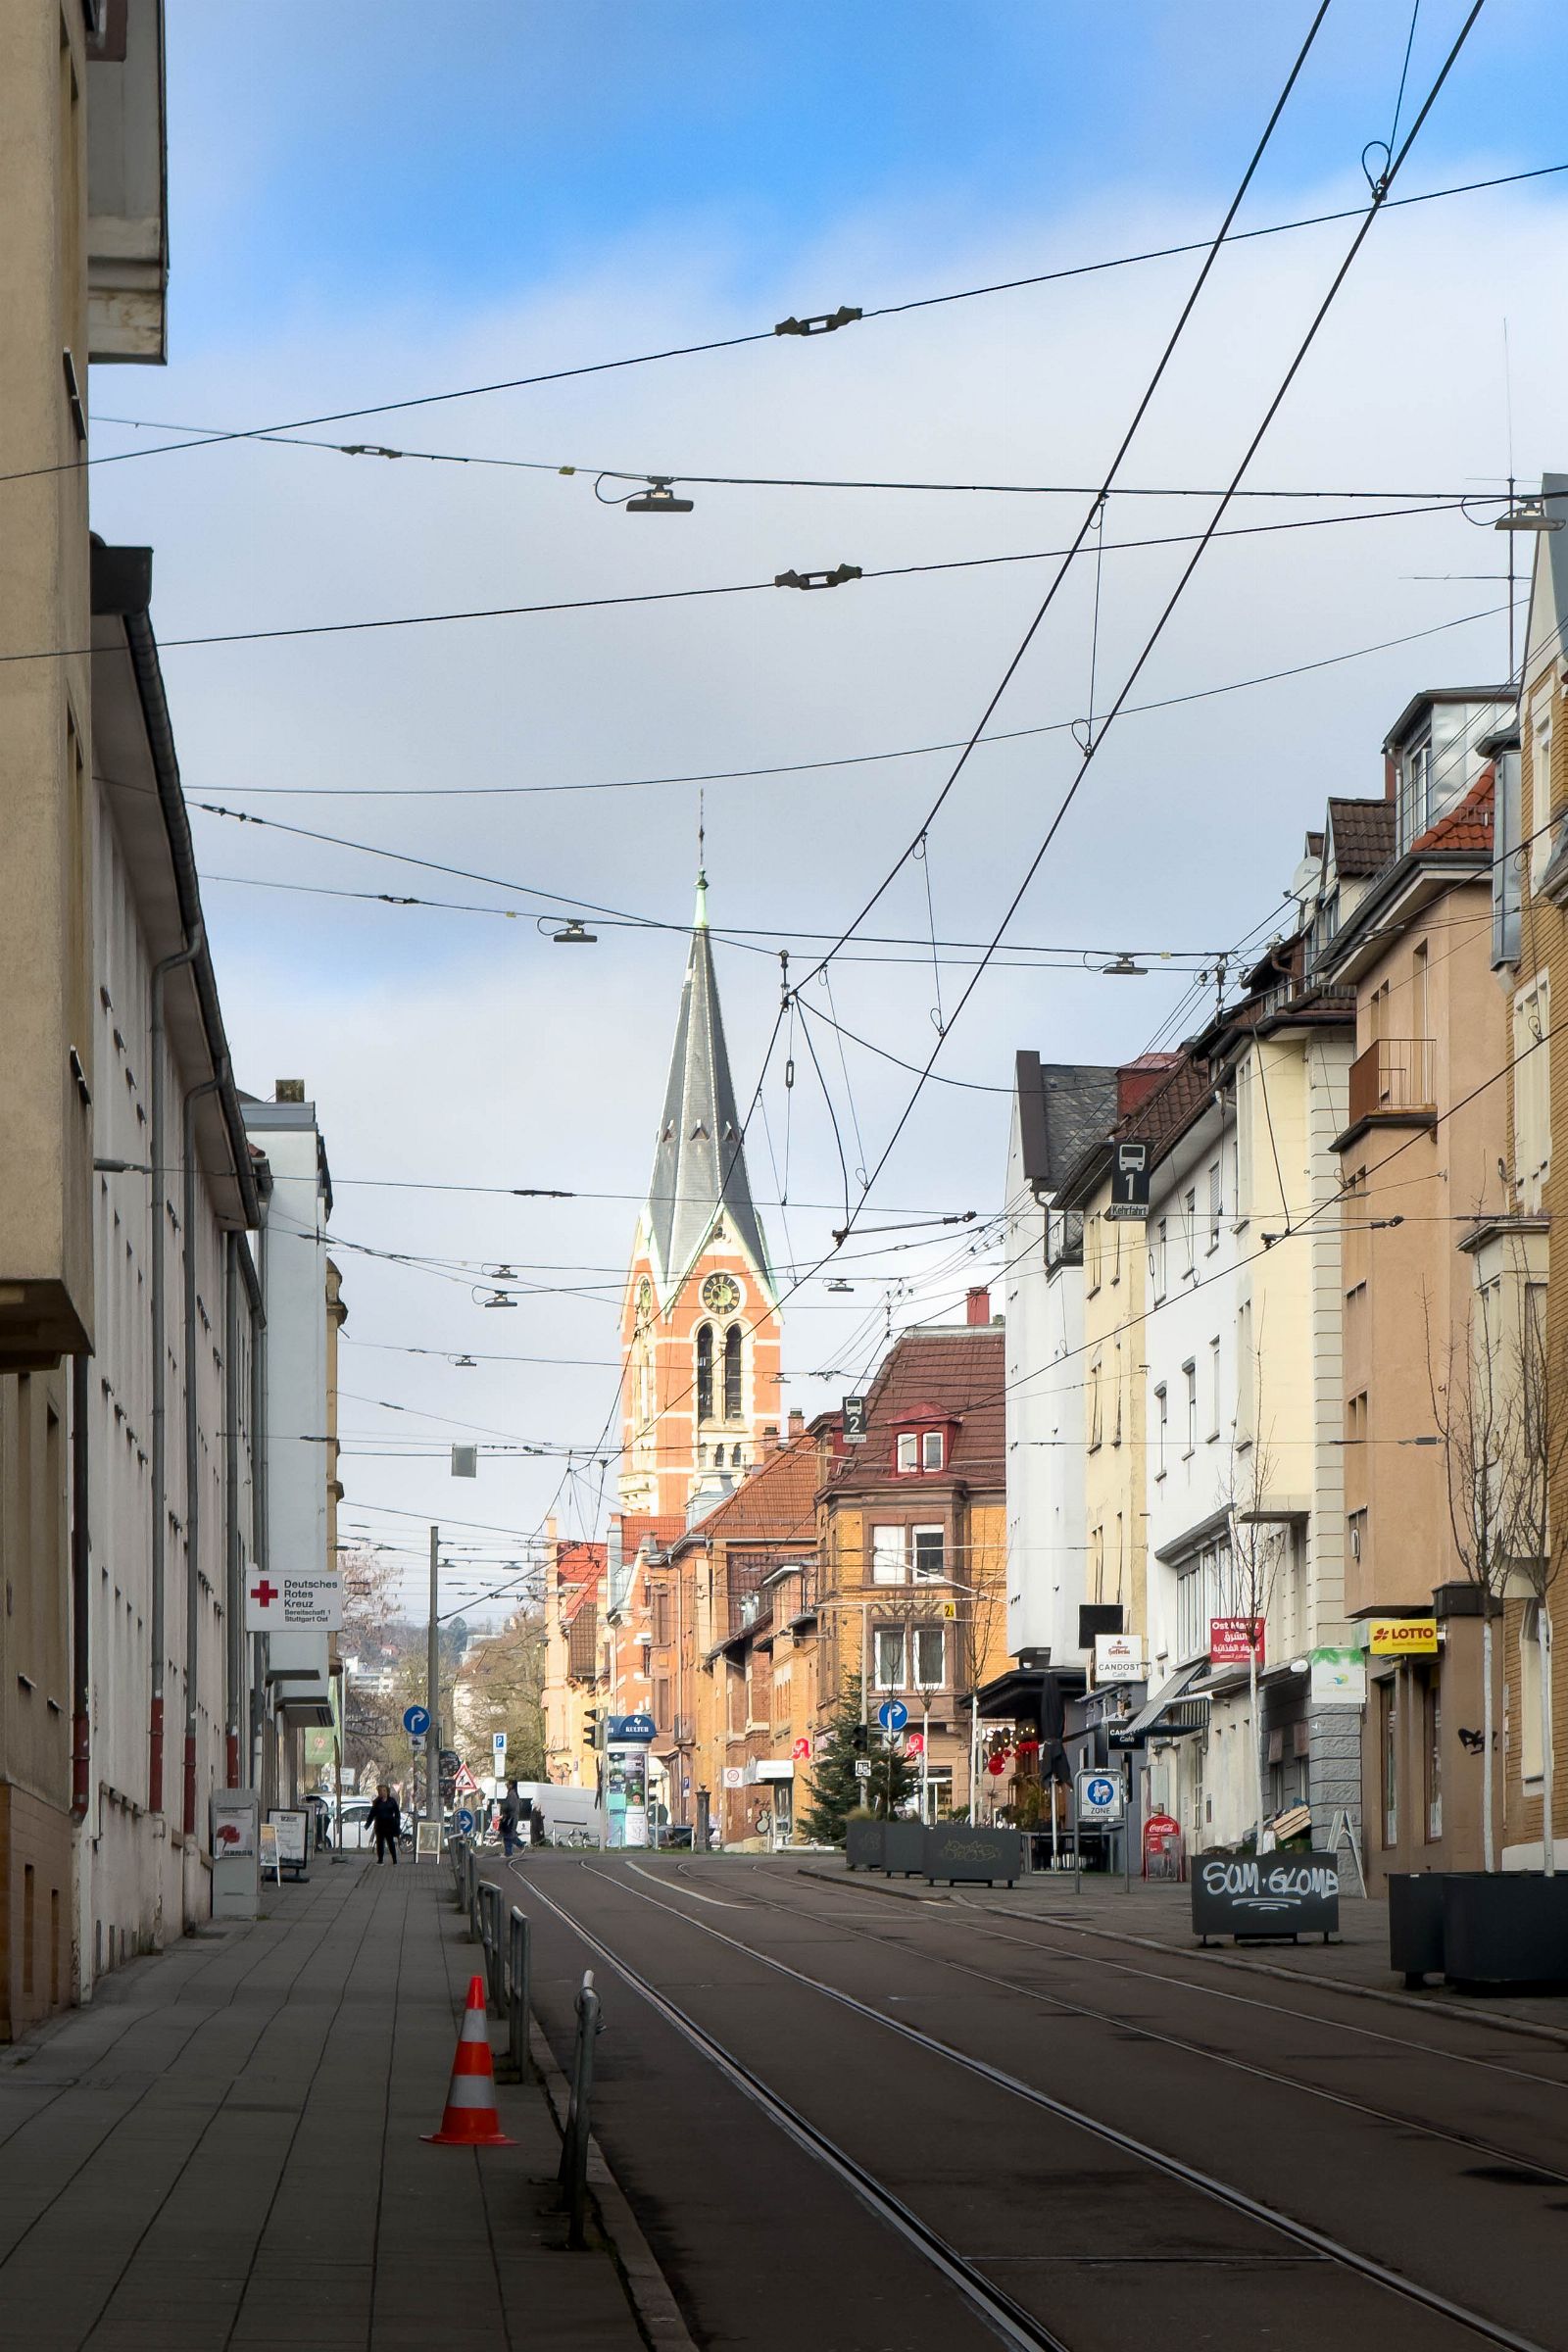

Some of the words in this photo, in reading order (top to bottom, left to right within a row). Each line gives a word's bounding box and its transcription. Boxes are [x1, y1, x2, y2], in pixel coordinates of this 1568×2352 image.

[1125, 1173, 1134, 1200] 1
[849, 1416, 860, 1434] 2
[284, 1579, 338, 1589] Deutsches
[284, 1590, 314, 1598] Rotes
[284, 1598, 314, 1608] Kreuz
[1211, 1621, 1229, 1630] Ost
[1392, 1627, 1435, 1640] LOTTO
